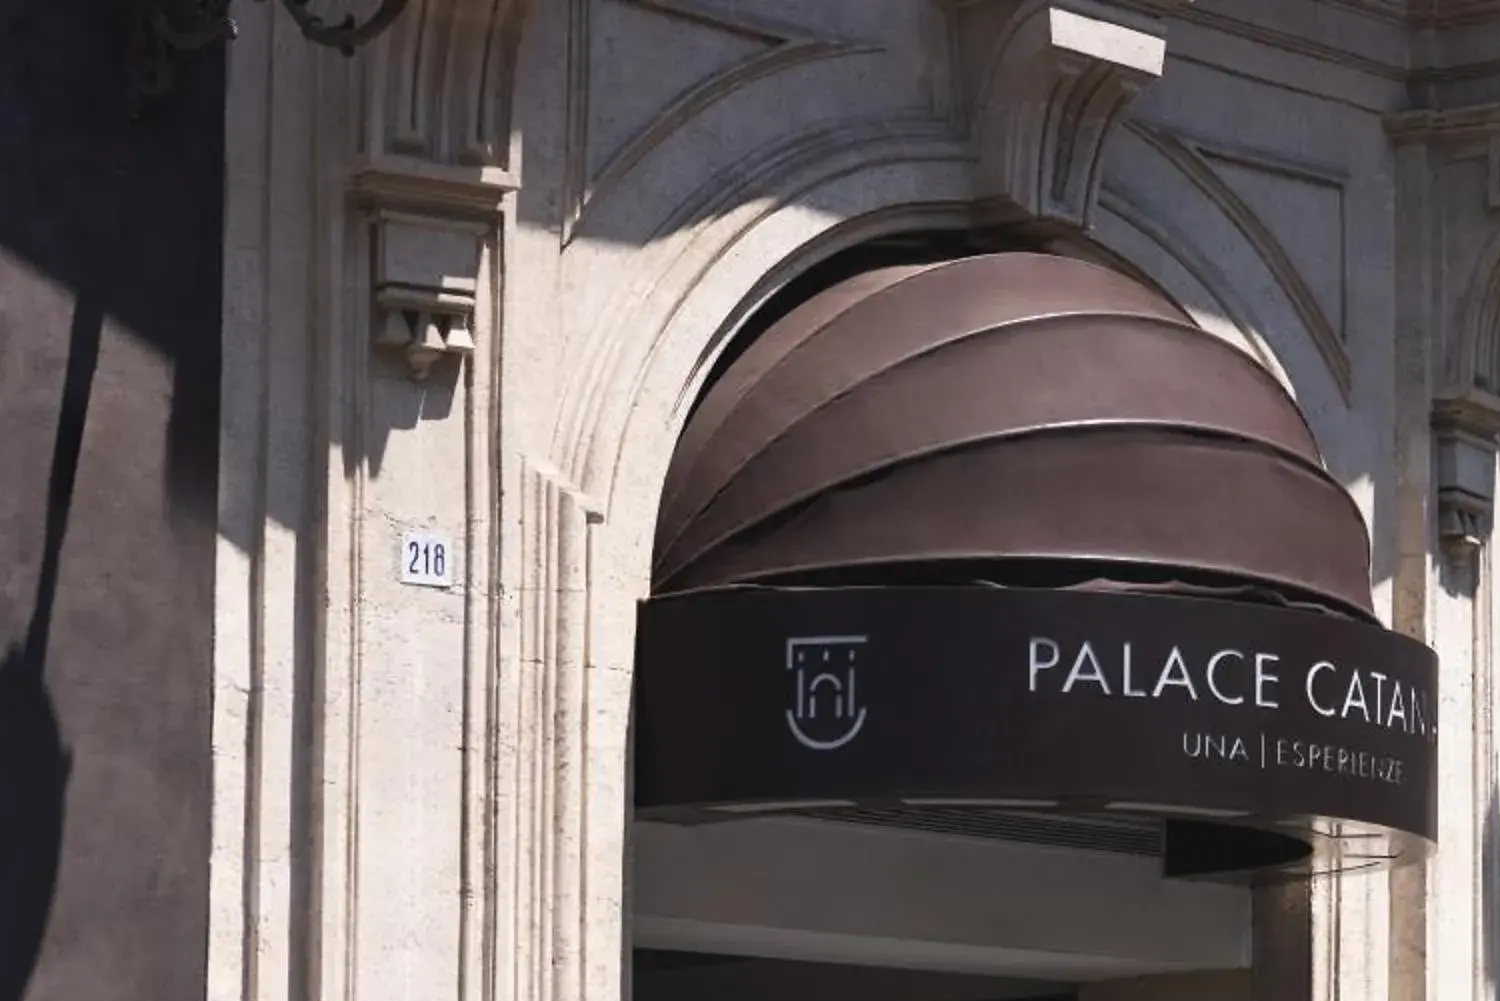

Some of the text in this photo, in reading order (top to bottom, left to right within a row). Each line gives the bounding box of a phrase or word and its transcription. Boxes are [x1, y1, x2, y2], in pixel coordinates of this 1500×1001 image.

[408, 541, 446, 577] 218
[1028, 635, 1438, 736] PALACE CATAN
[1183, 732, 1249, 761] UNA
